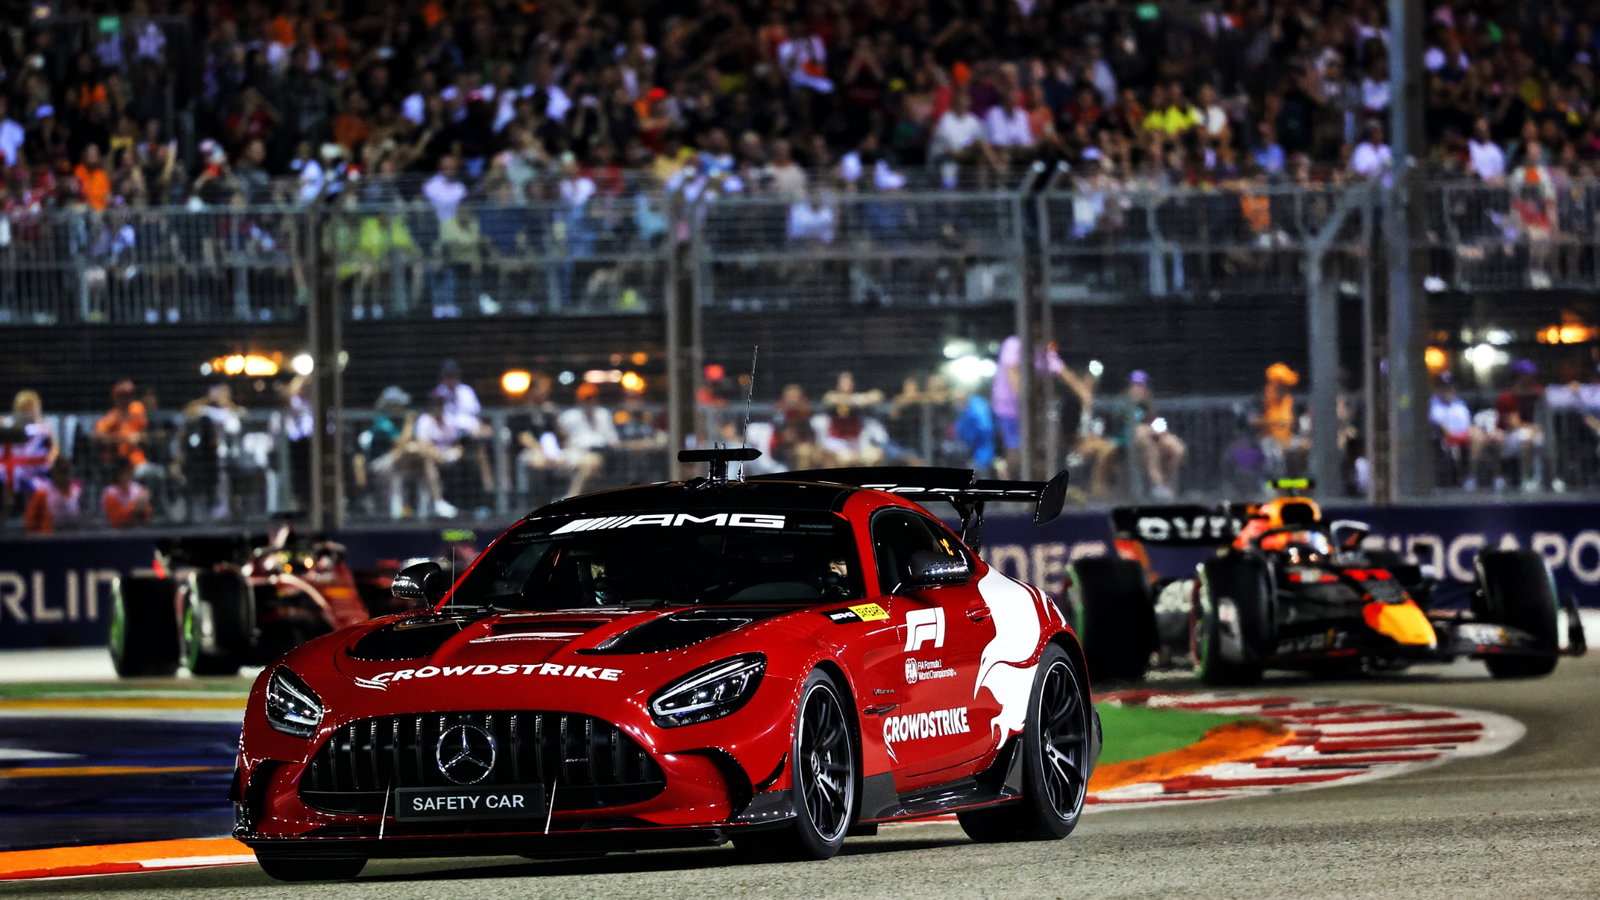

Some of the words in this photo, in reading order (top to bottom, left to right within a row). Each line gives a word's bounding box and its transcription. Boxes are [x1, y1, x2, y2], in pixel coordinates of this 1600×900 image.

[610, 513, 786, 530] AMG
[369, 662, 624, 682] CROWDSTRIKE
[883, 706, 971, 743] CROWDSTRIKE
[412, 795, 480, 811] SAFETY
[485, 794, 525, 809] CAR
